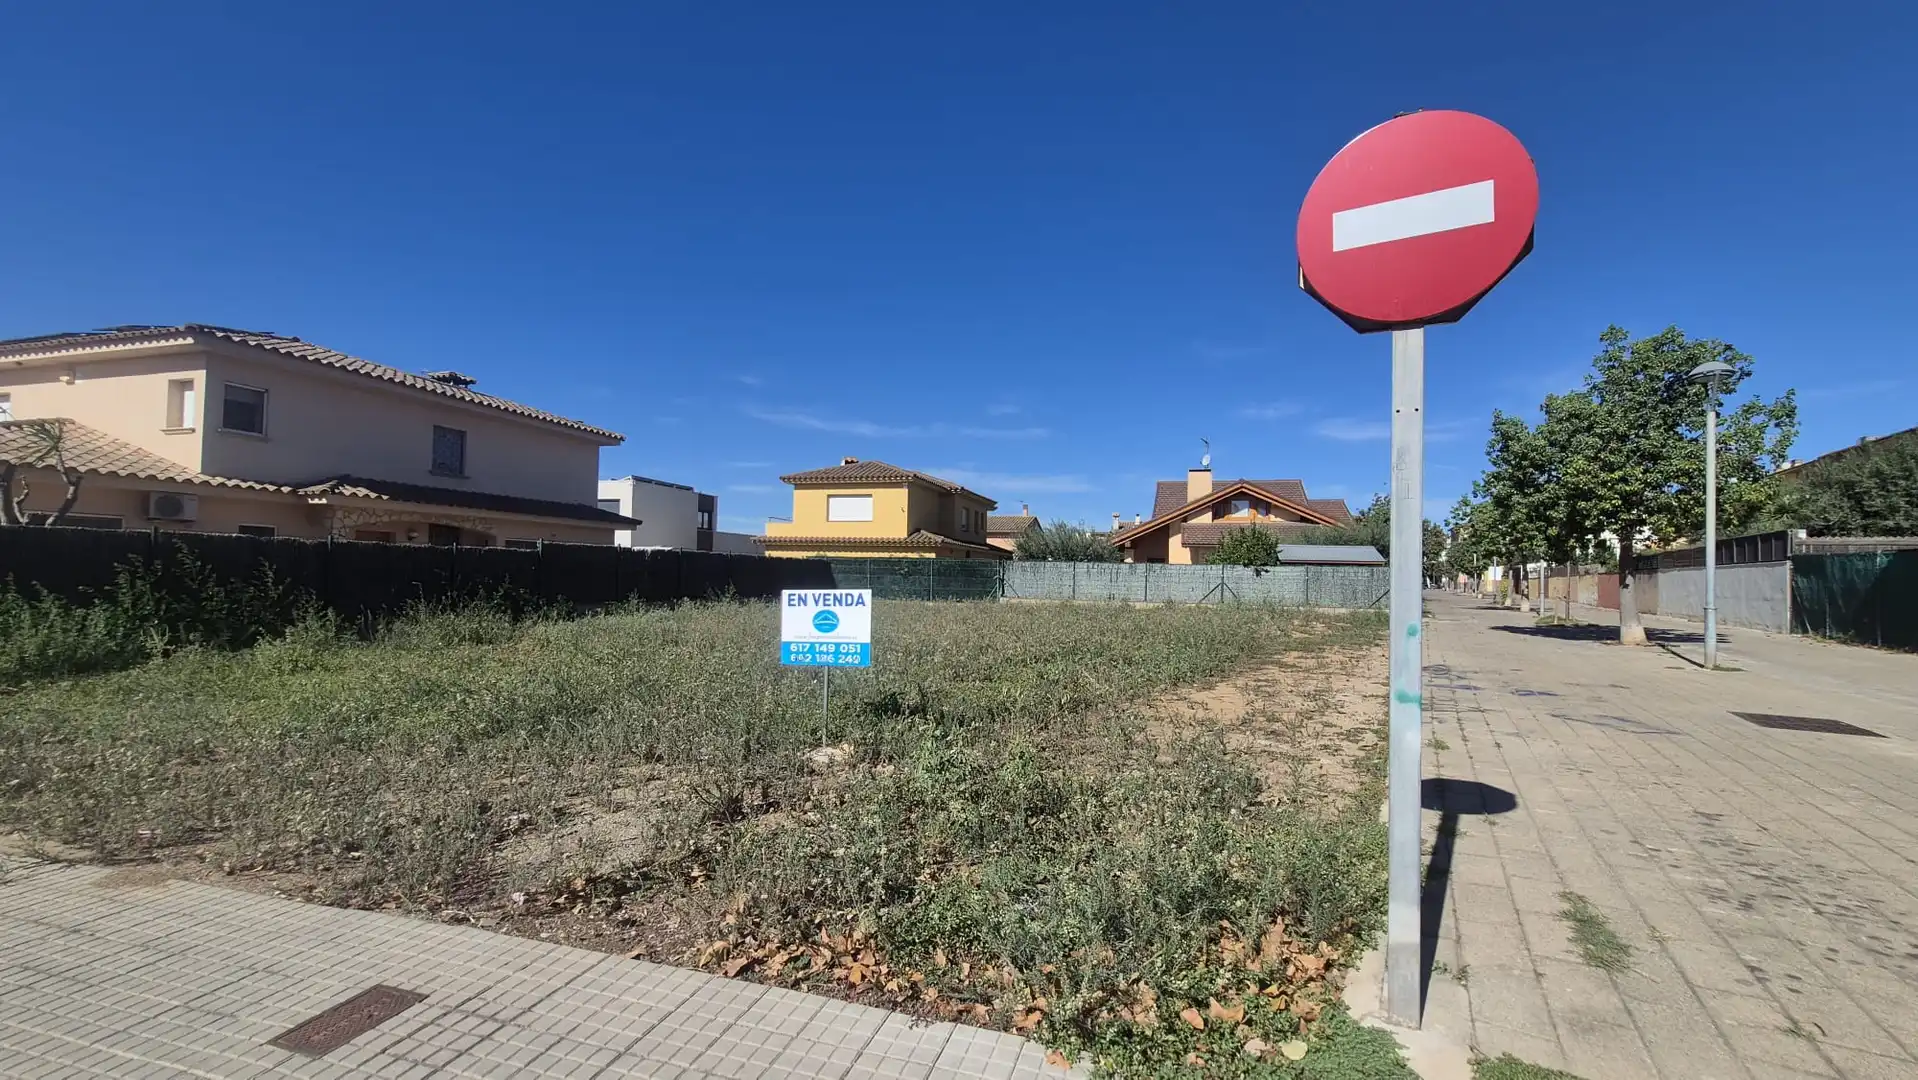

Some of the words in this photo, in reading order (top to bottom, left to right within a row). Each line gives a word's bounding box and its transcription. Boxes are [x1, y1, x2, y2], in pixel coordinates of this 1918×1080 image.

[787, 593, 808, 607] EN
[812, 593, 866, 607] VENDA
[790, 643, 811, 652] 617
[815, 643, 836, 653] 149
[840, 644, 861, 653] 051
